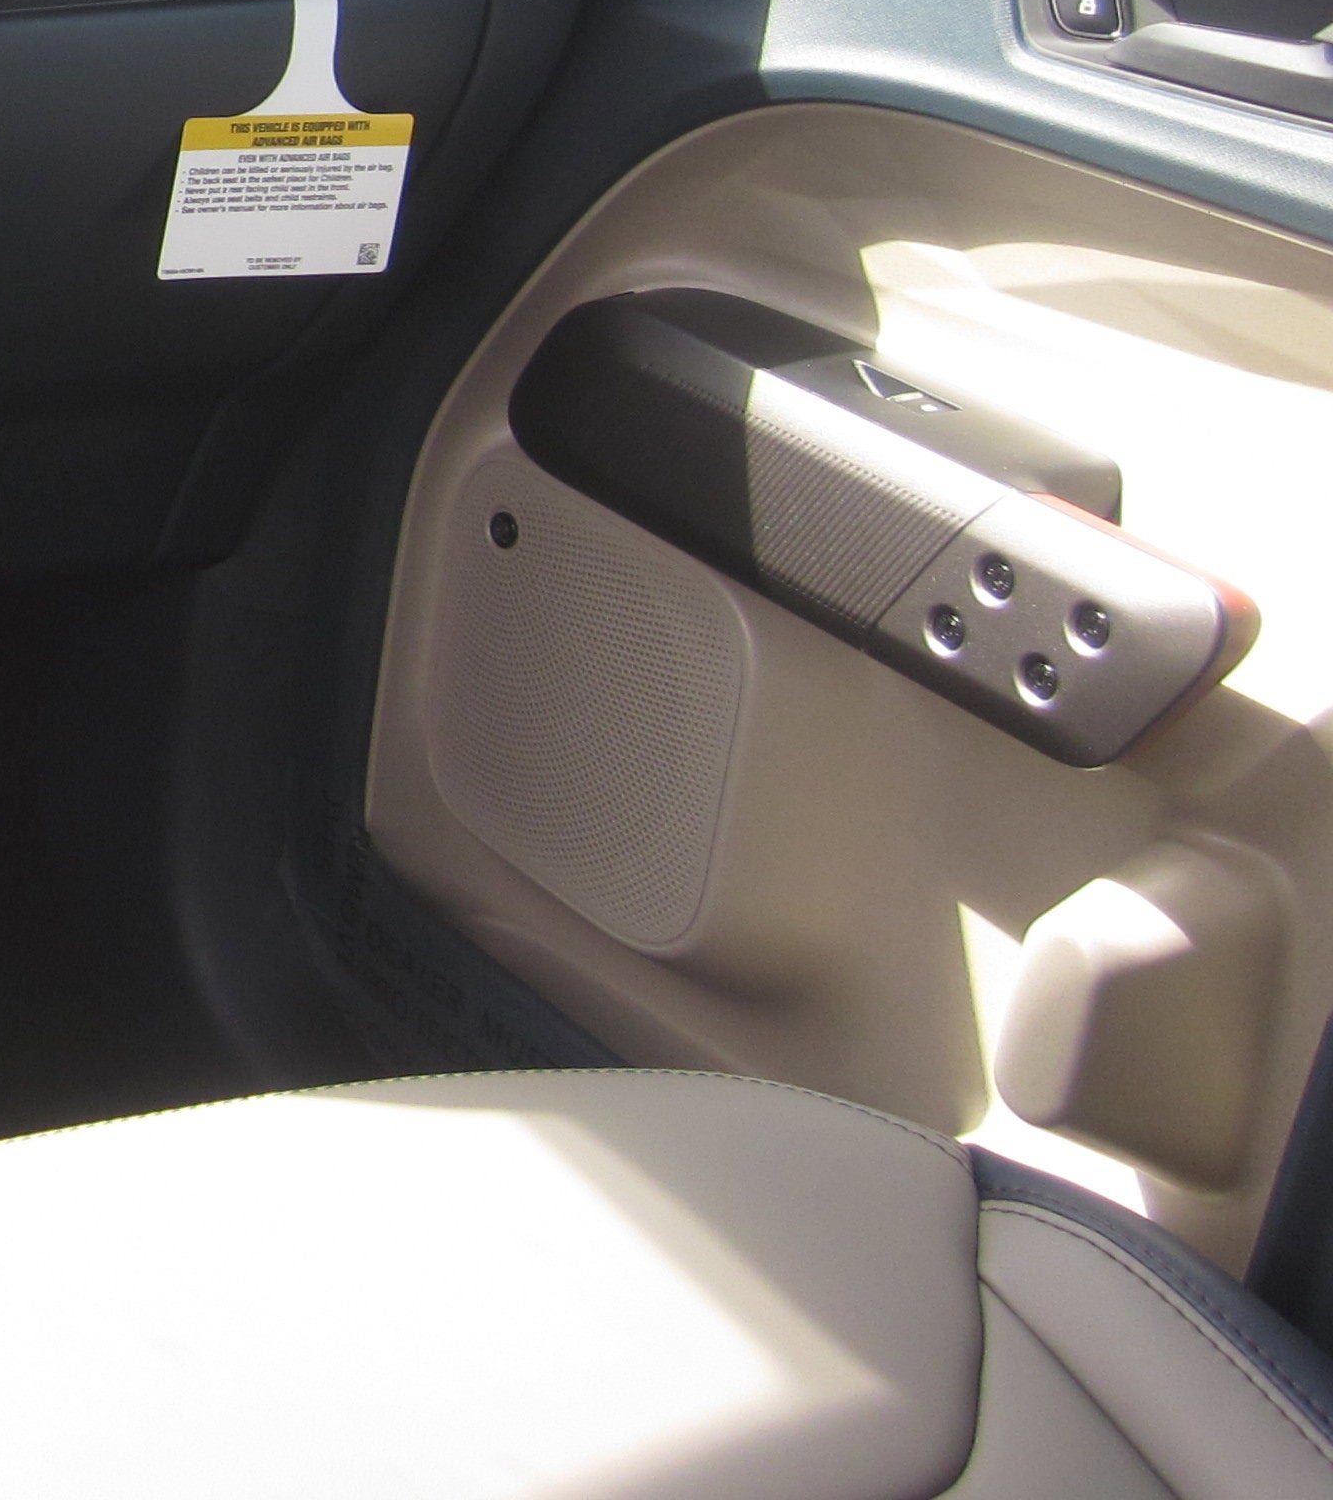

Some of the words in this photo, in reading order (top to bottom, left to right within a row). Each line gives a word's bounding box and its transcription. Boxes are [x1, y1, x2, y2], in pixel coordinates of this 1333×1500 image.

[231, 123, 251, 134] THIS
[253, 122, 289, 133] VEHICLE
[291, 122, 301, 132] IS
[302, 121, 346, 132] EQUIPPED
[347, 120, 370, 131] WITH
[252, 135, 300, 147] ADVANCED
[301, 135, 318, 146] AIR
[319, 134, 343, 146] BAGS
